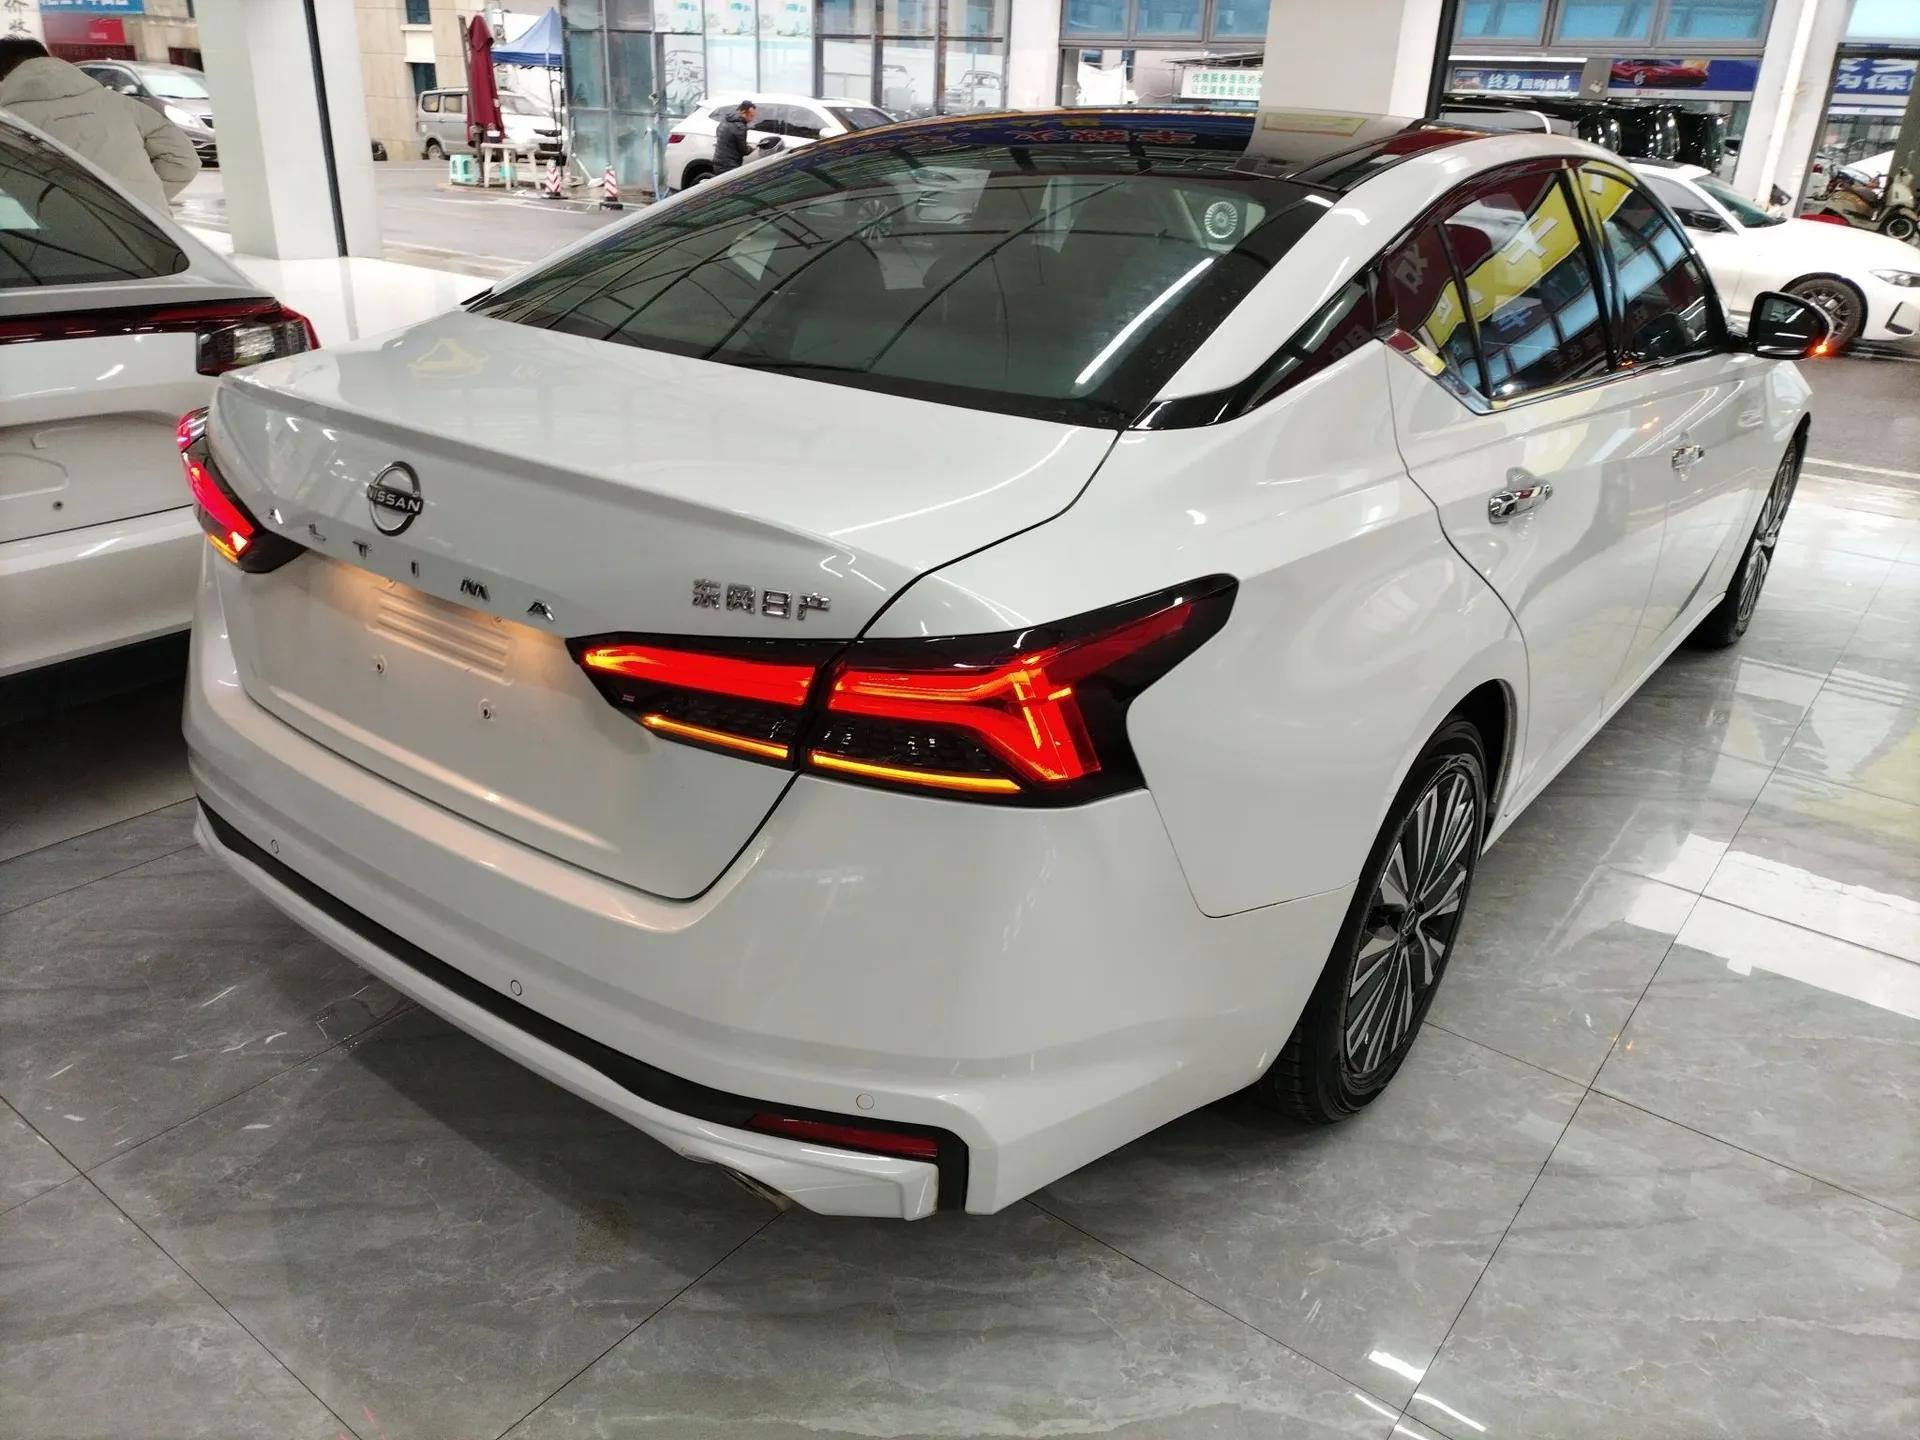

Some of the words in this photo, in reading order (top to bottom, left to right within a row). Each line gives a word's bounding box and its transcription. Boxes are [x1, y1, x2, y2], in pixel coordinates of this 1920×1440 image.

[367, 486, 421, 512] NISSAN
[268, 508, 556, 622] ALTIMA
[692, 578, 831, 620] 东风日产
